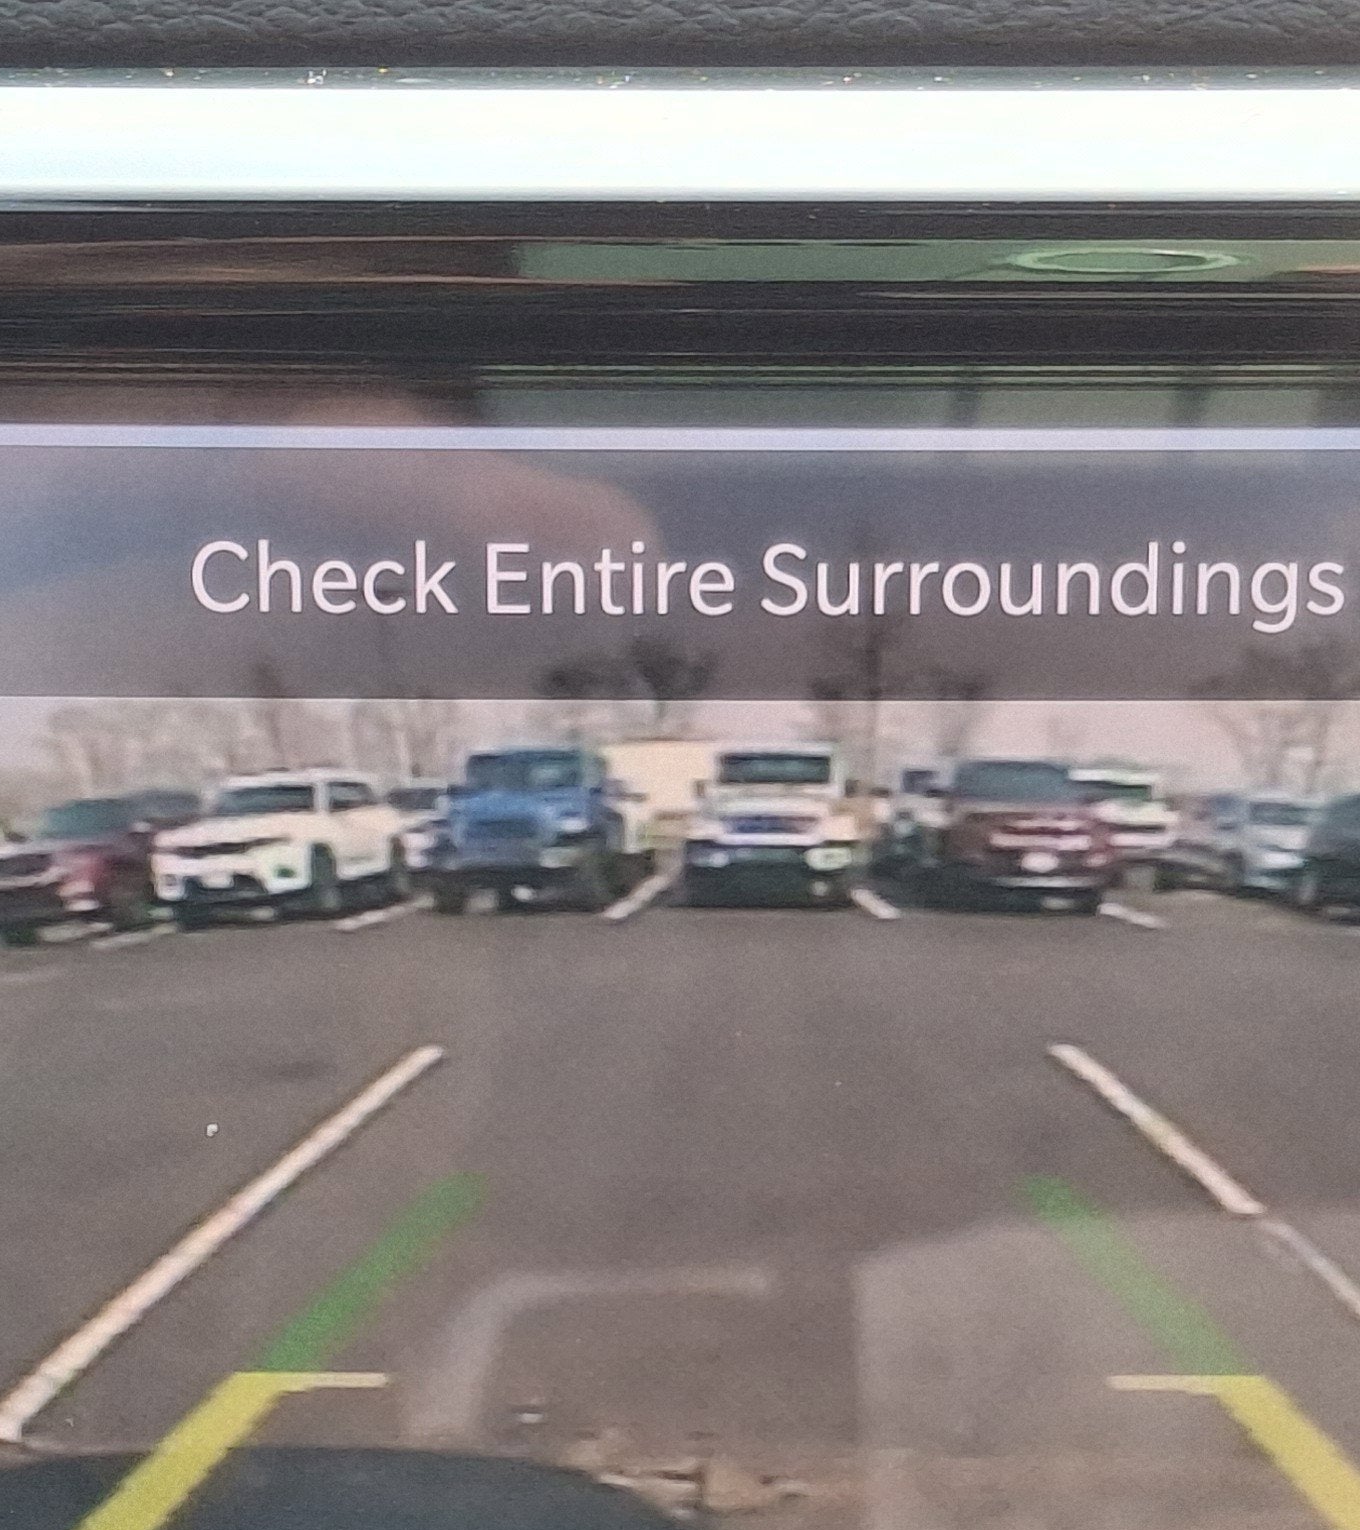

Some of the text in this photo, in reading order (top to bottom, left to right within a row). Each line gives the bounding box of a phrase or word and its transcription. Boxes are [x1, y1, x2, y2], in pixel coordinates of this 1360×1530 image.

[190, 538, 1346, 633] Check Entire Surroundings
